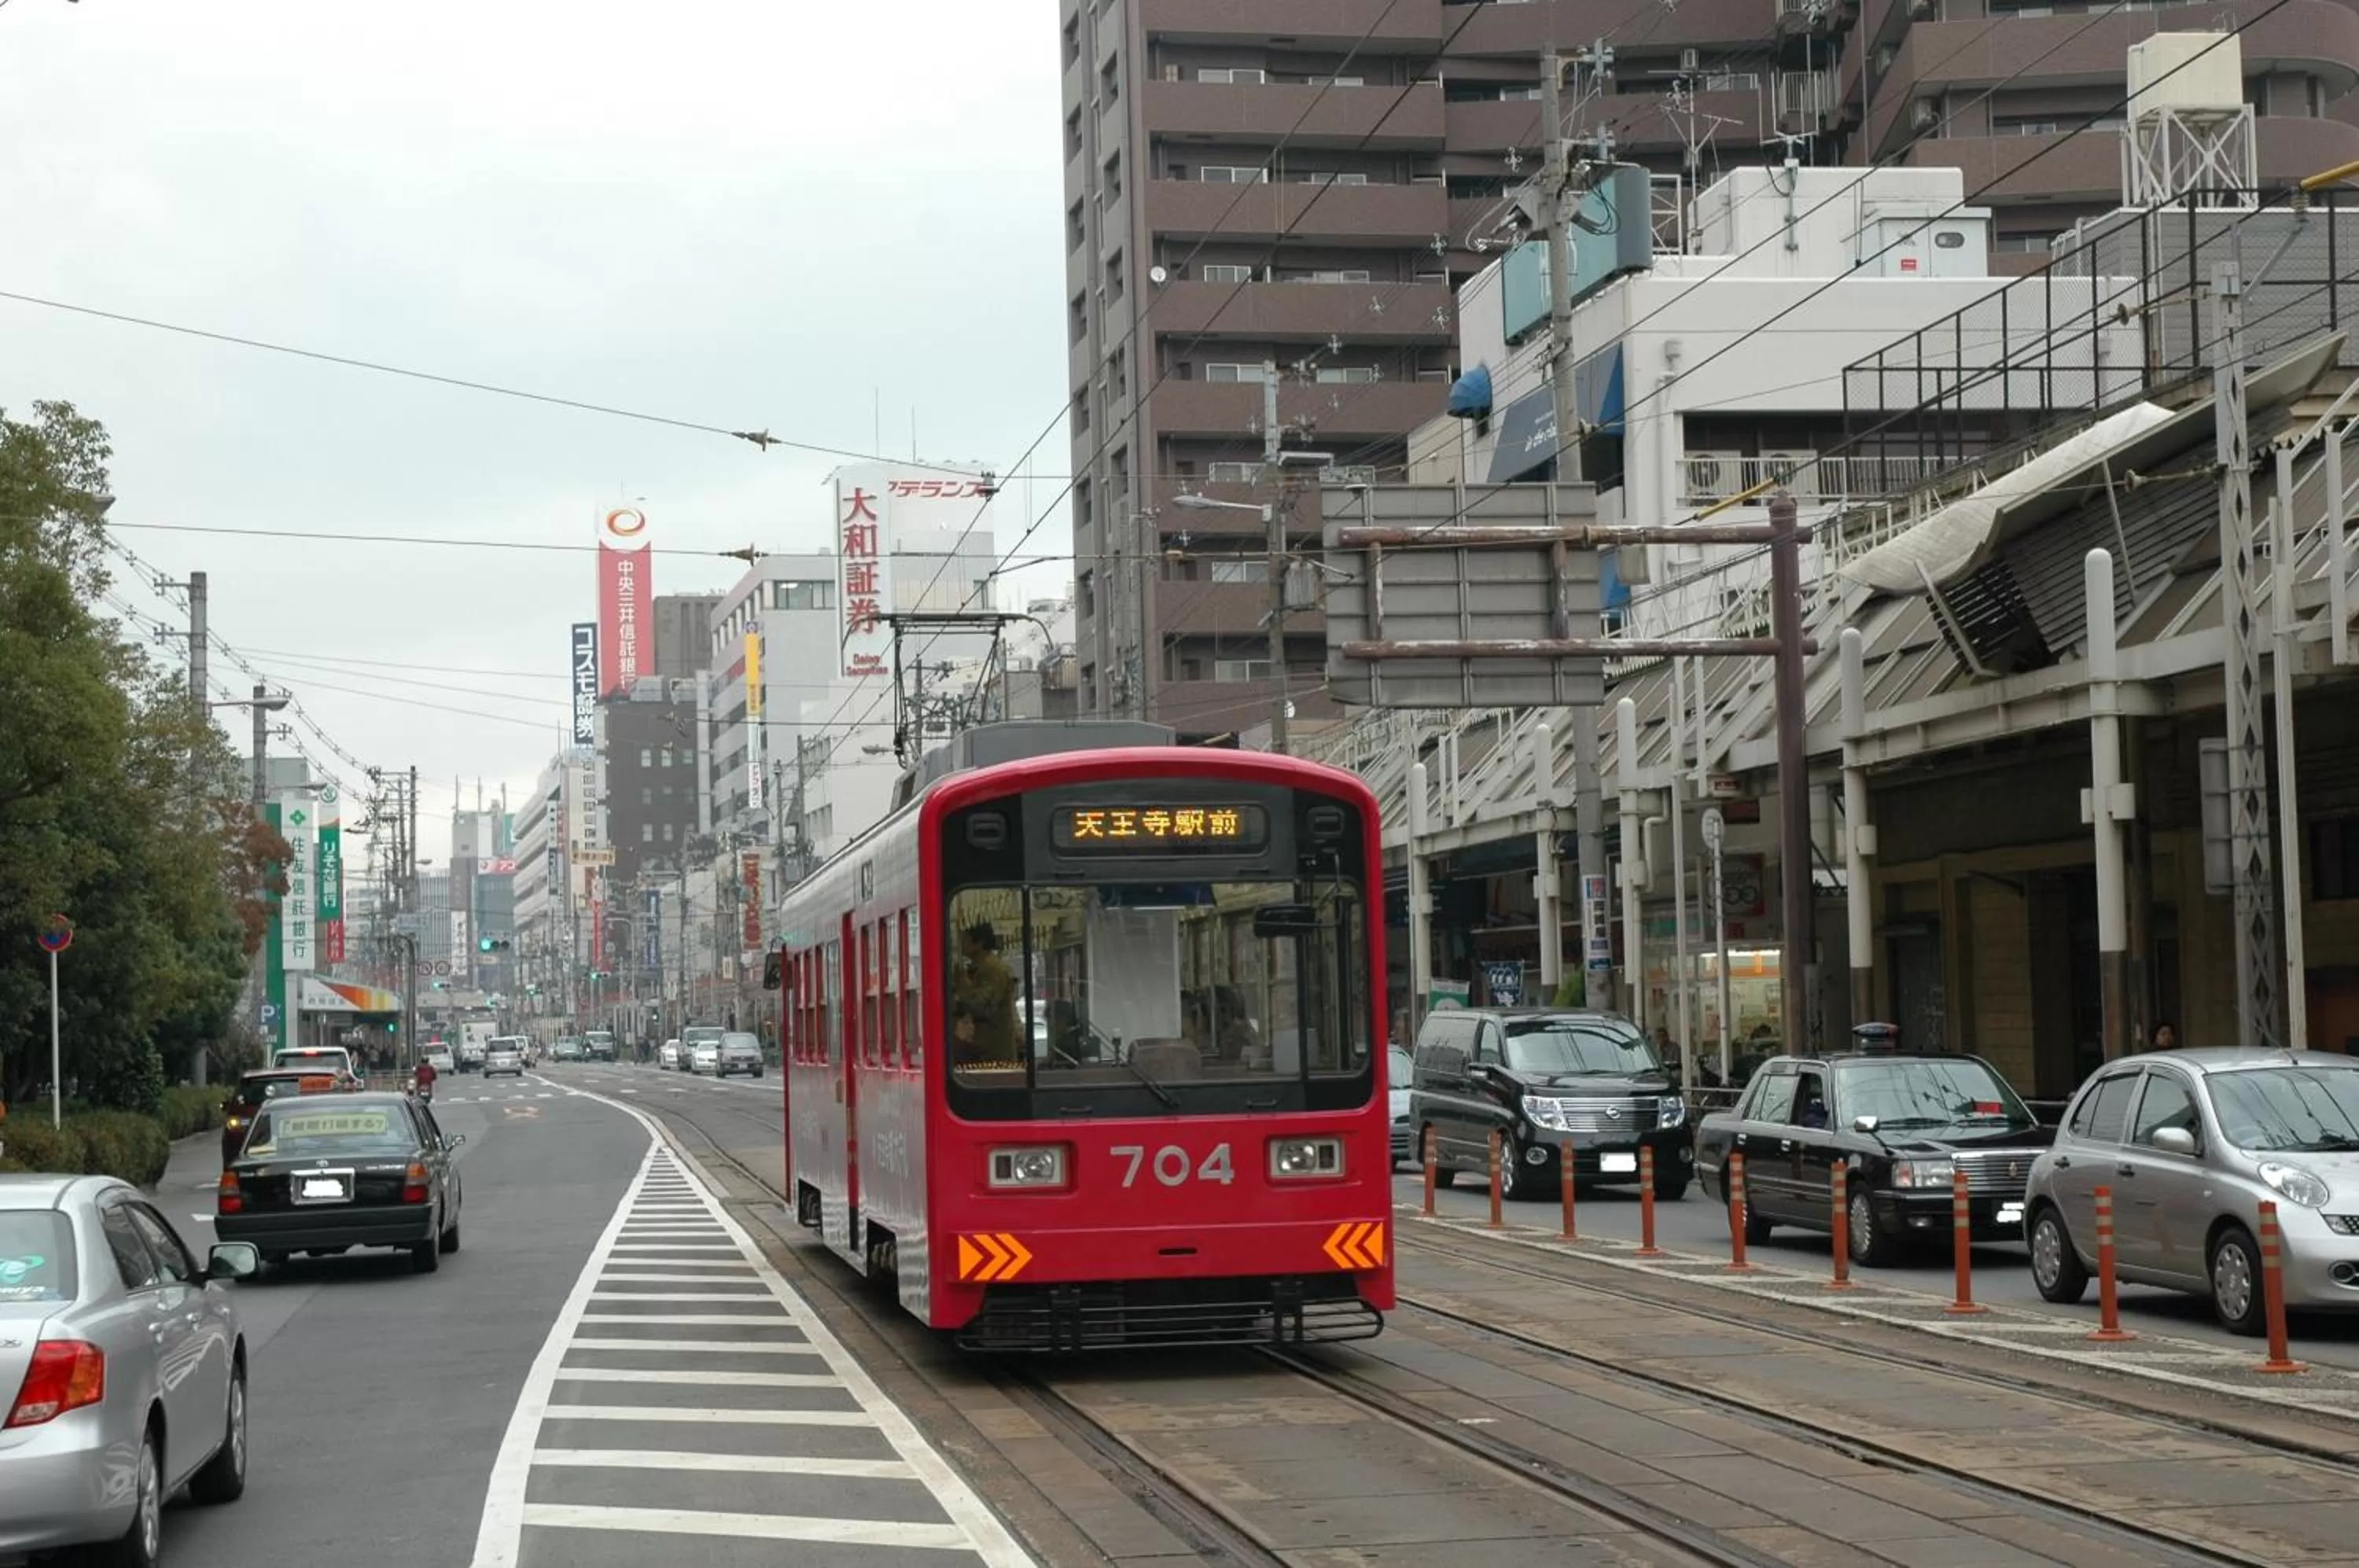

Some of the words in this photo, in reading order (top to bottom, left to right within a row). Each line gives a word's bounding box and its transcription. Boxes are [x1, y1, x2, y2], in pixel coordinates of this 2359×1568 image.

[842, 487, 881, 635] 大和証券
[575, 627, 596, 738] コスモ証券
[1074, 809, 1238, 837] 天王寺駅前
[291, 836, 306, 959] 住友信託銀行
[260, 1004, 275, 1023] P
[1110, 1143, 1235, 1188] 704
